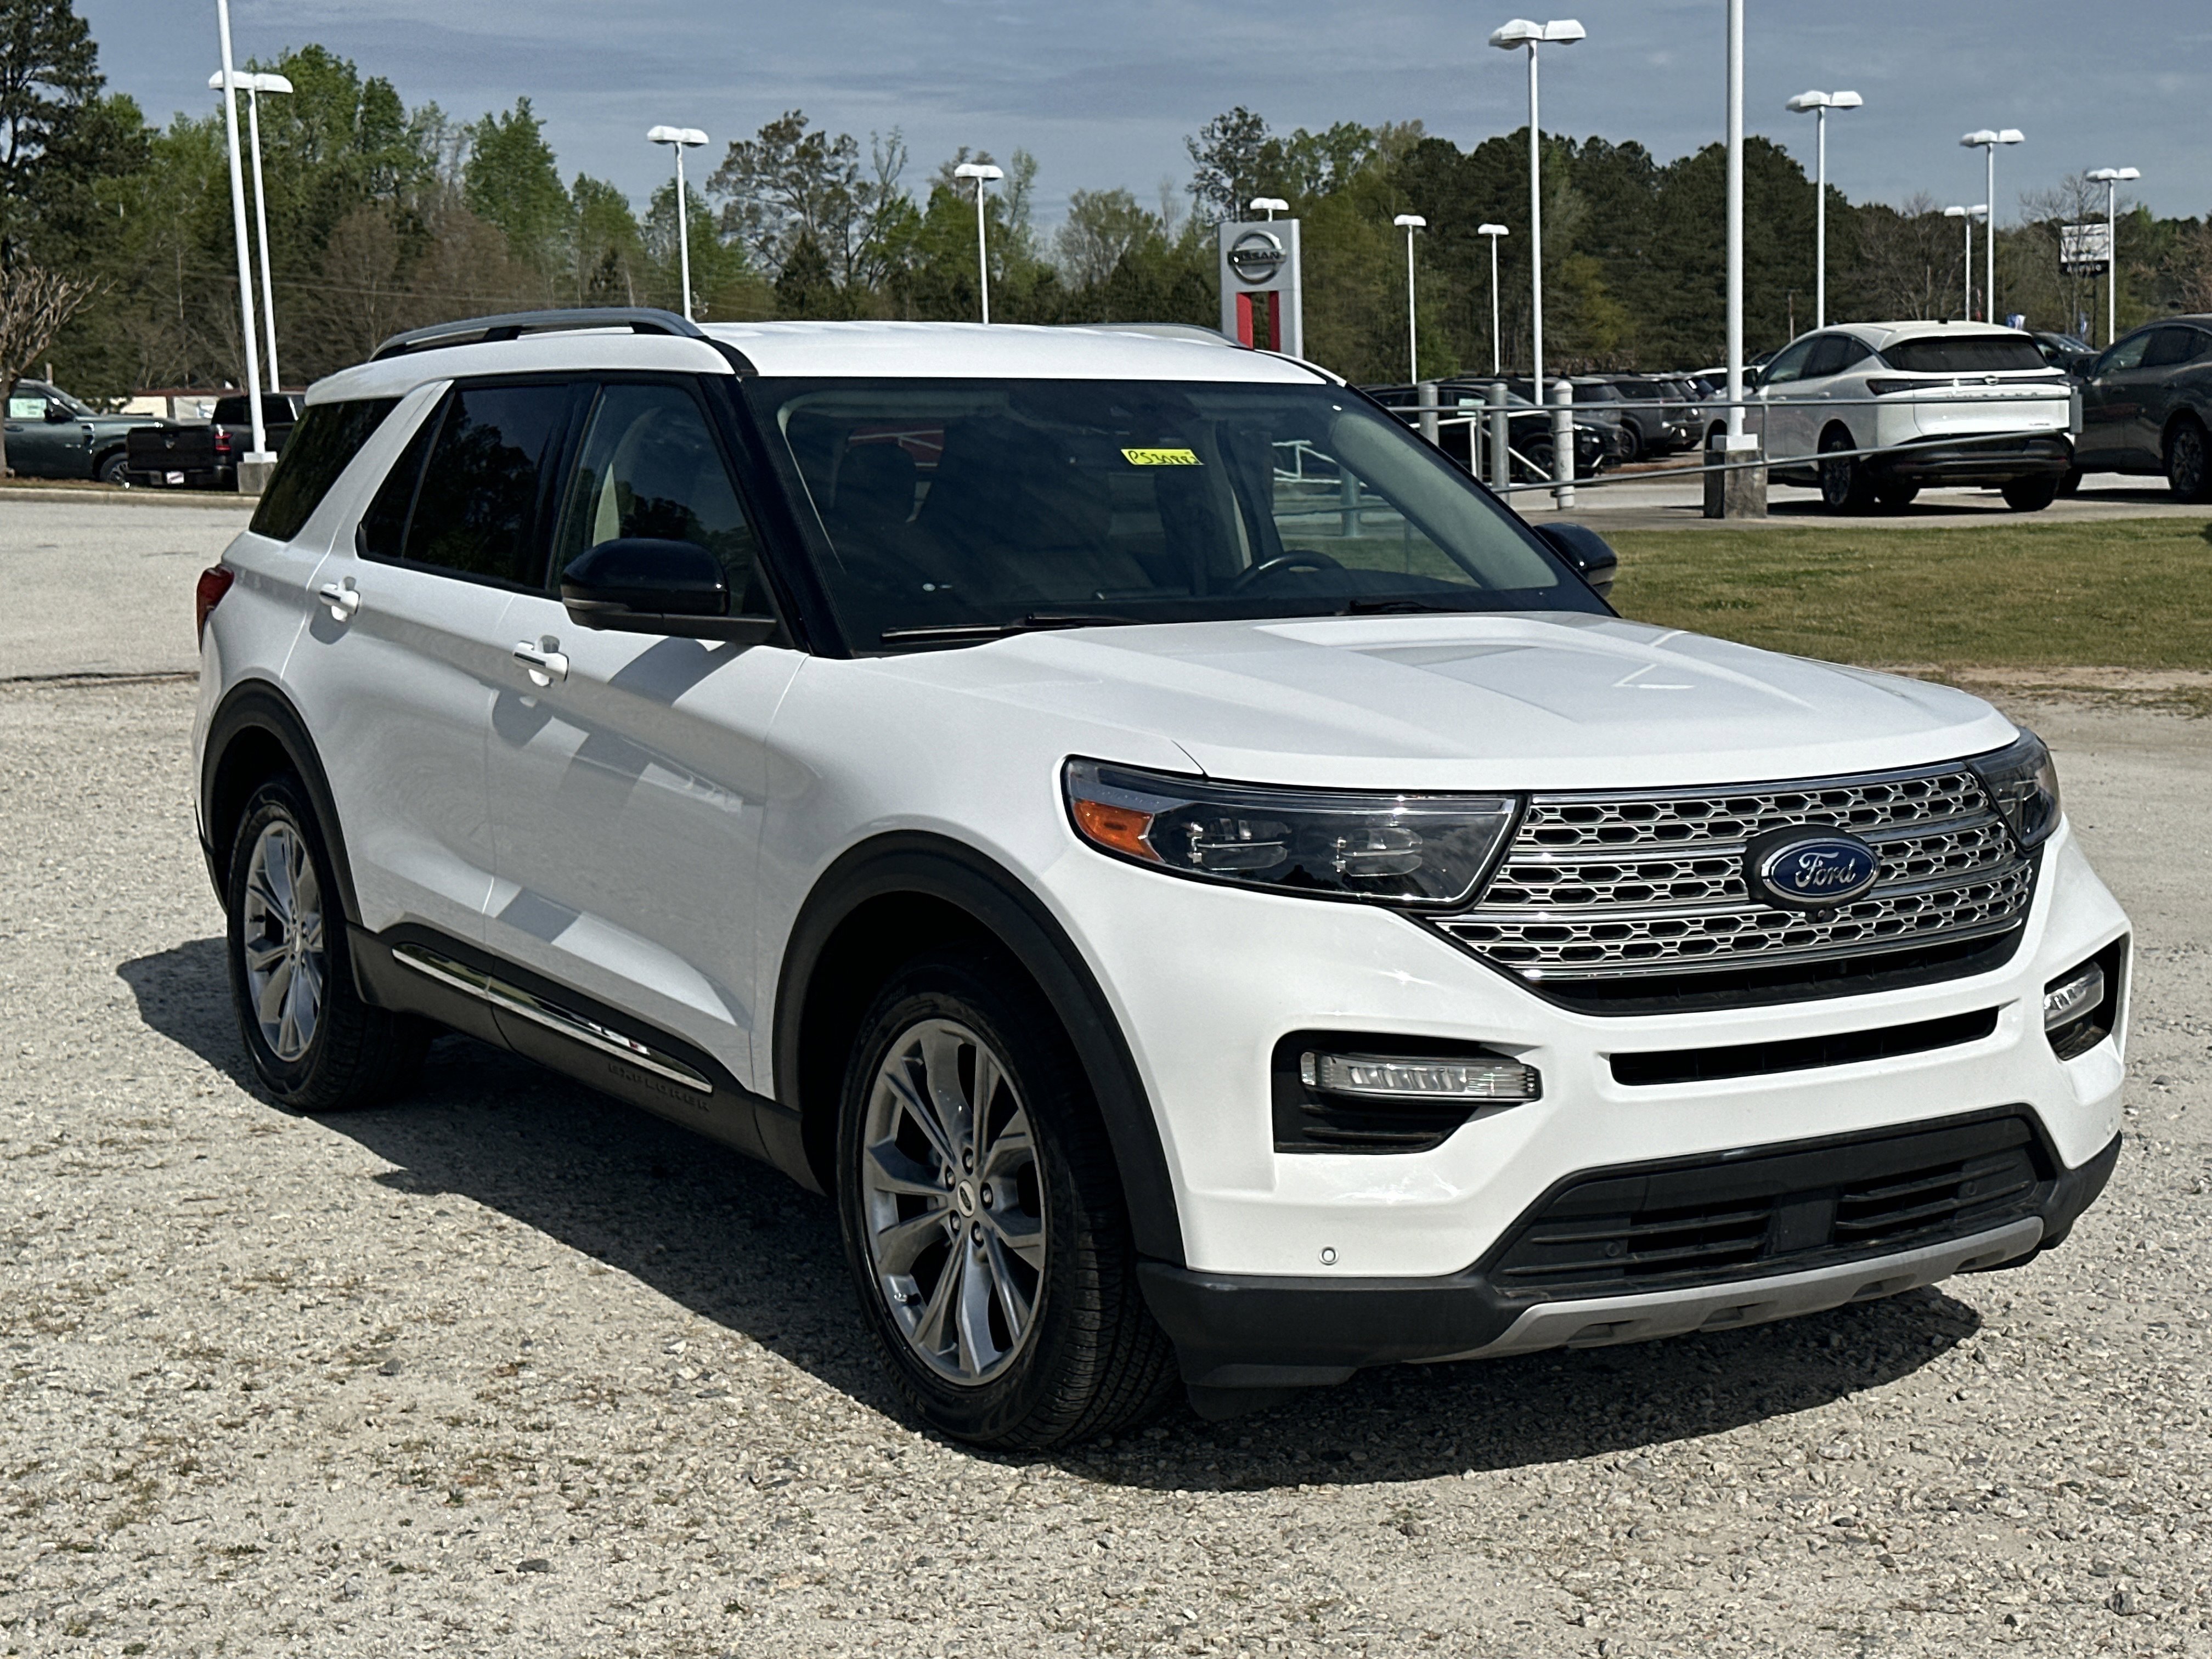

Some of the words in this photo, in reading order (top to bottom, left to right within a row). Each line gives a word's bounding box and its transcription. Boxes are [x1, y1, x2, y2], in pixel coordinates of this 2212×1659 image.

[1232, 251, 1280, 261] ISSAN
[1795, 852, 1857, 888] Ford
[608, 1062, 710, 1112] EXPLORER
